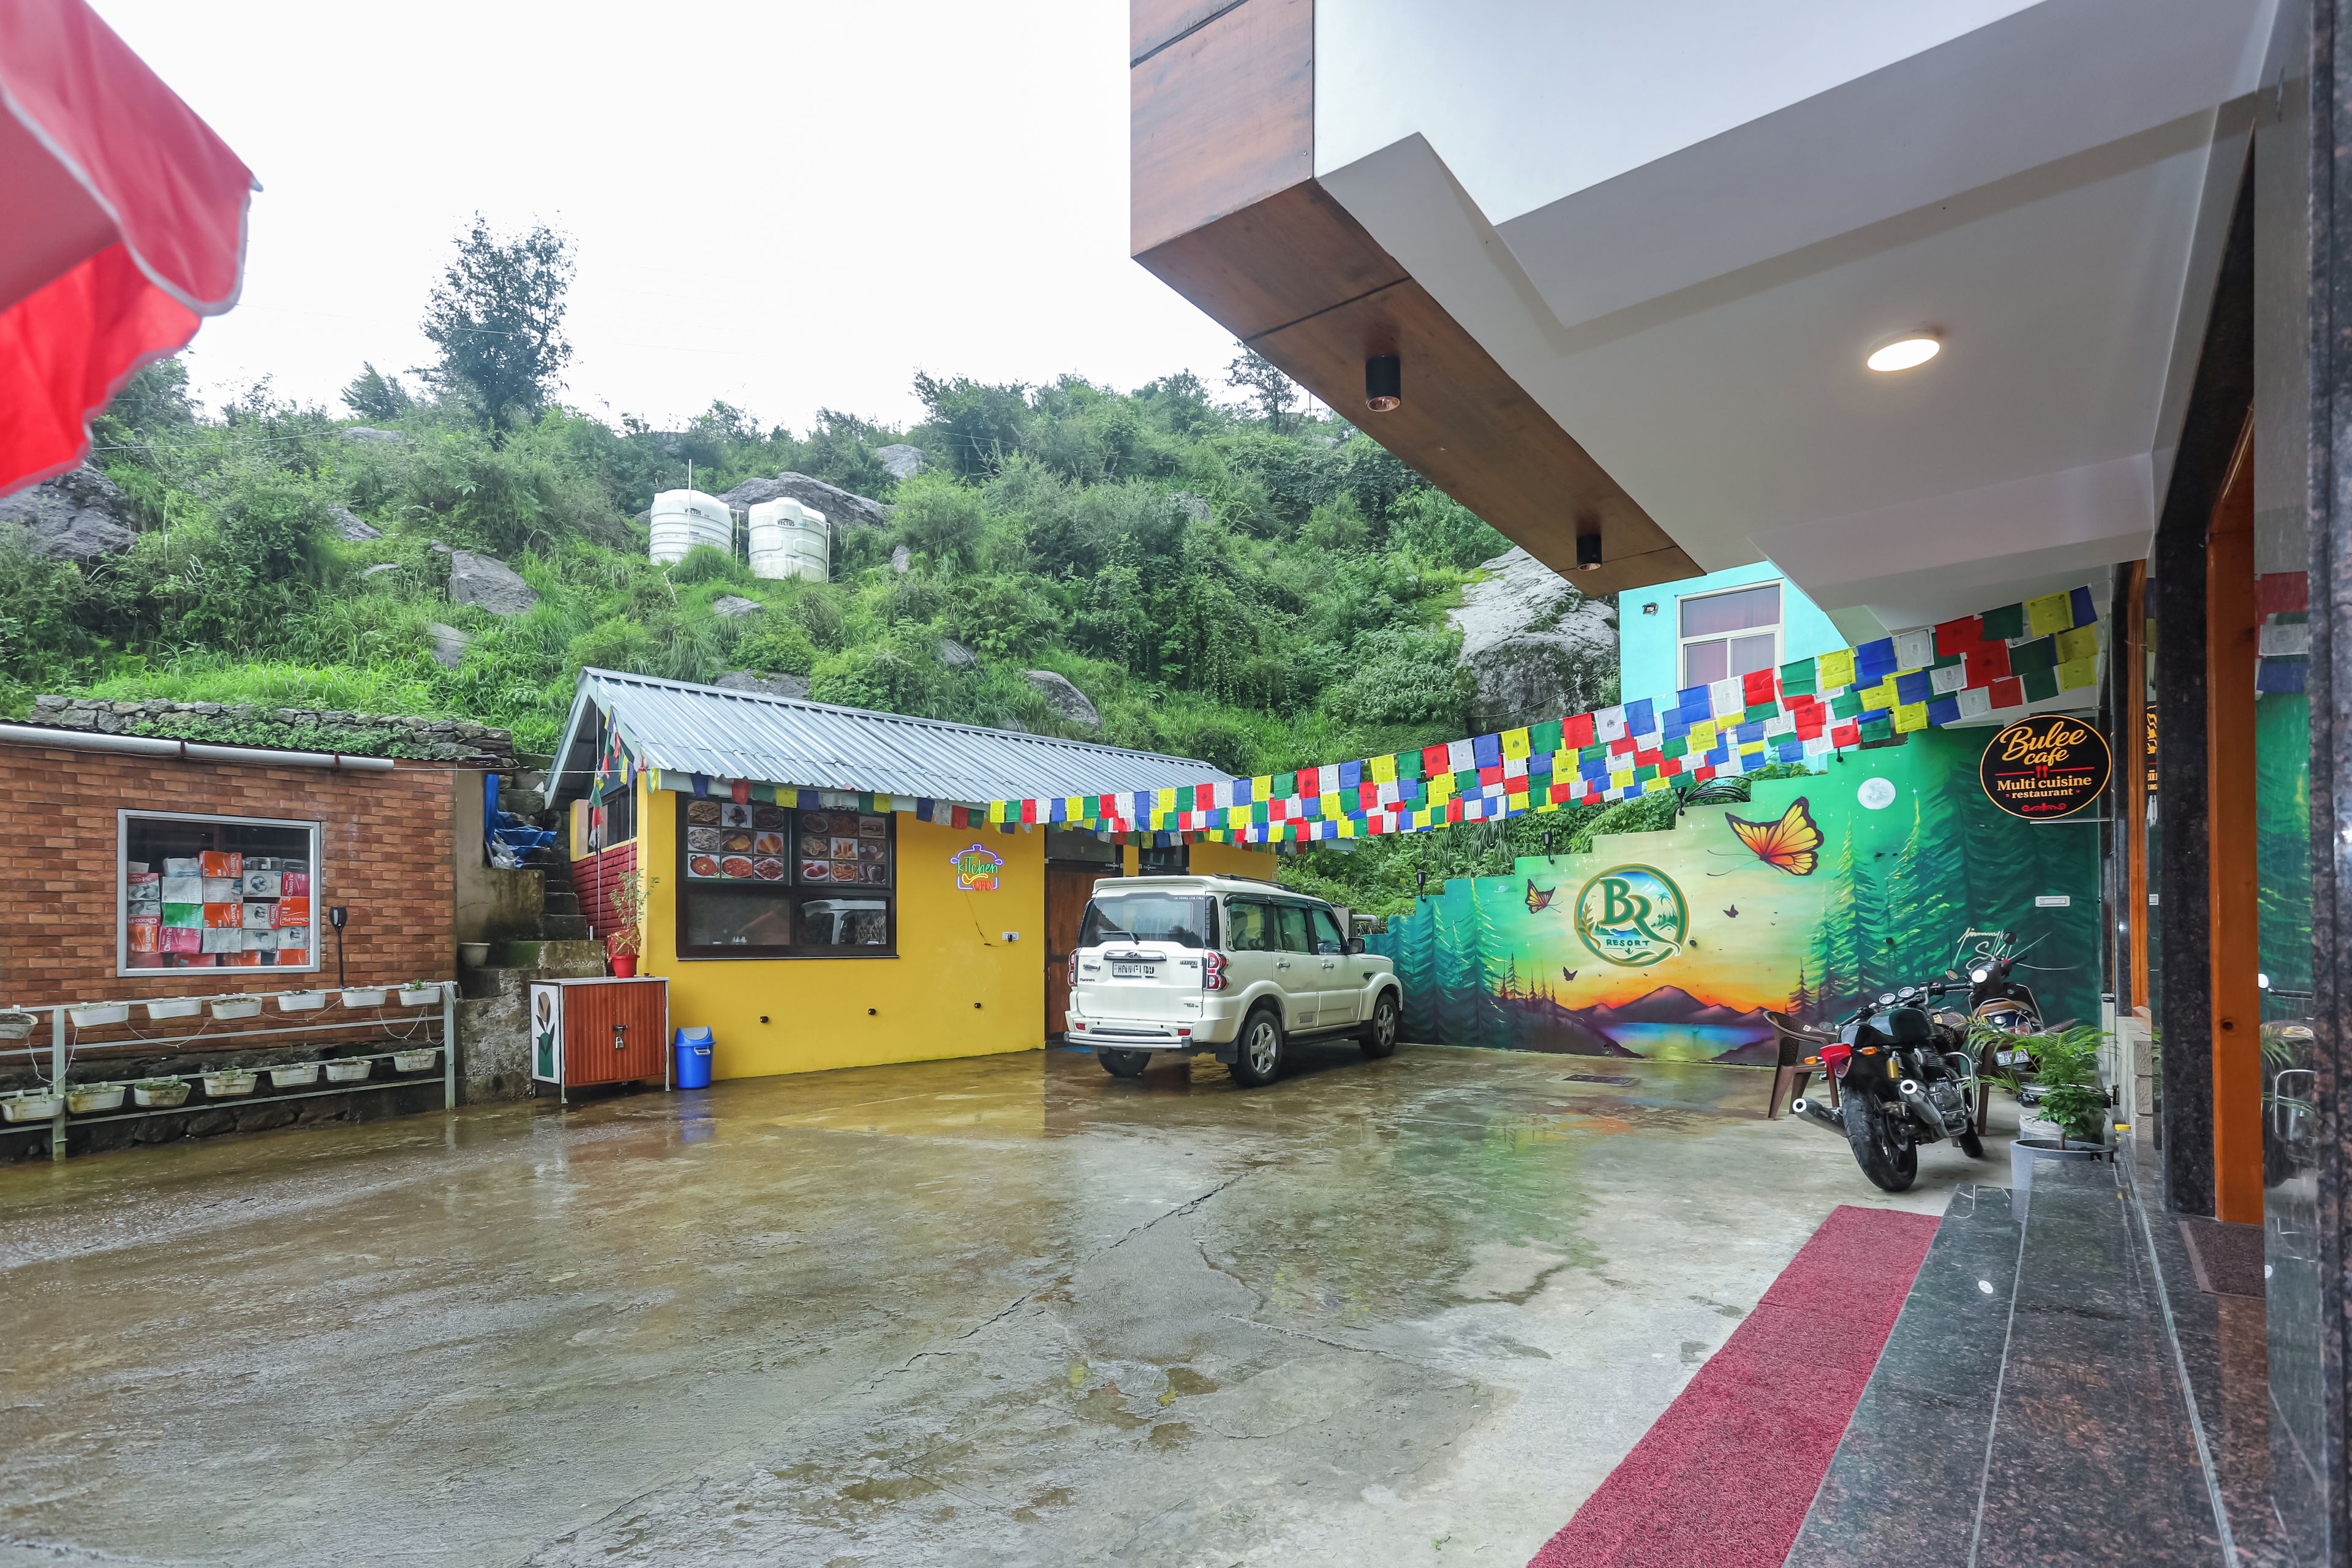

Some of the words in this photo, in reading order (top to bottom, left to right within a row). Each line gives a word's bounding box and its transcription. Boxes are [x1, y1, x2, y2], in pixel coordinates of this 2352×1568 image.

[1999, 721, 2087, 761] Bulee
[2024, 747, 2070, 766] cafe
[1997, 778, 2035, 791] Multi
[2038, 775, 2092, 788] cuisine
[2011, 788, 2073, 798] restaurant
[1597, 877, 1677, 952] BR
